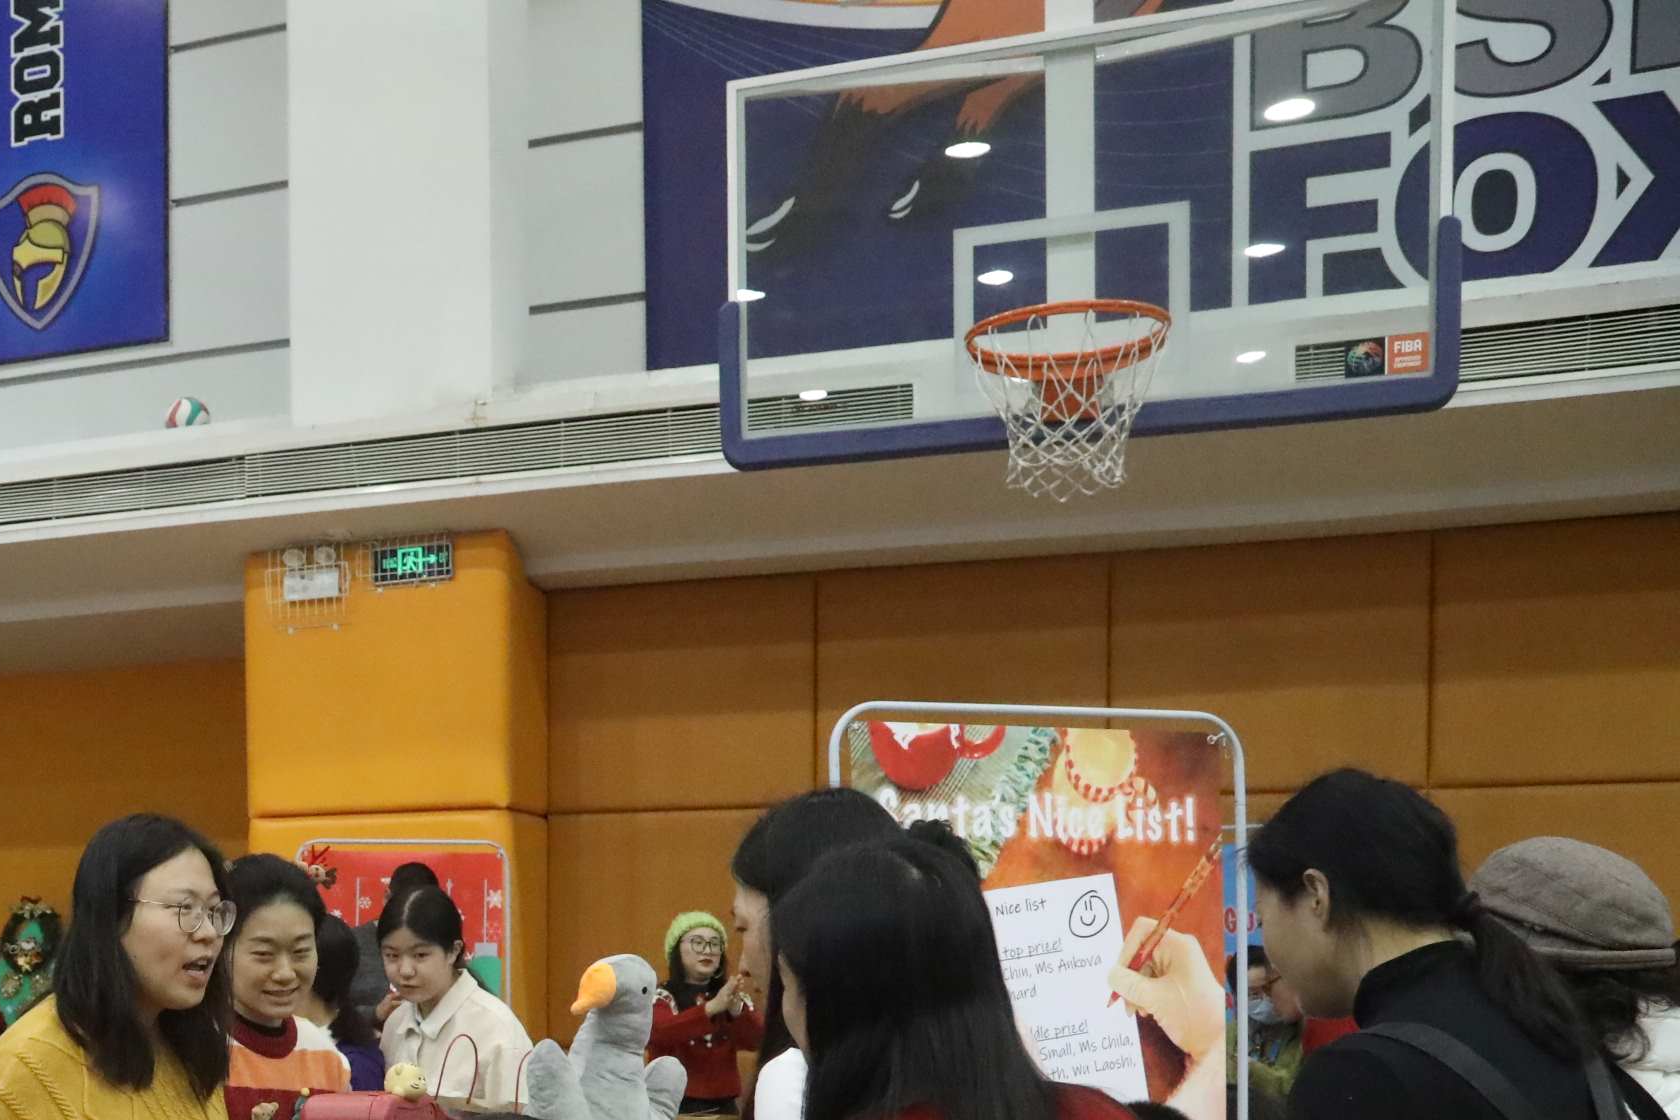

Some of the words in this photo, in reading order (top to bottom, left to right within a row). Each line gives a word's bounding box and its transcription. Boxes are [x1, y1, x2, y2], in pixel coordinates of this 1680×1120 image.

[10, 0, 64, 147] ROM
[1394, 339, 1422, 353] FIBA
[876, 787, 1017, 838] Santa's
[1027, 791, 1107, 840] Nice
[1116, 793, 1197, 842] List!
[995, 902, 1021, 917] Nice
[1025, 898, 1047, 913] list
[1002, 946, 1024, 960] top
[1027, 938, 1064, 958] prize!
[1035, 960, 1055, 976] Ms
[1054, 1019, 1089, 1039] prize!
[1079, 1039, 1098, 1054] Ms
